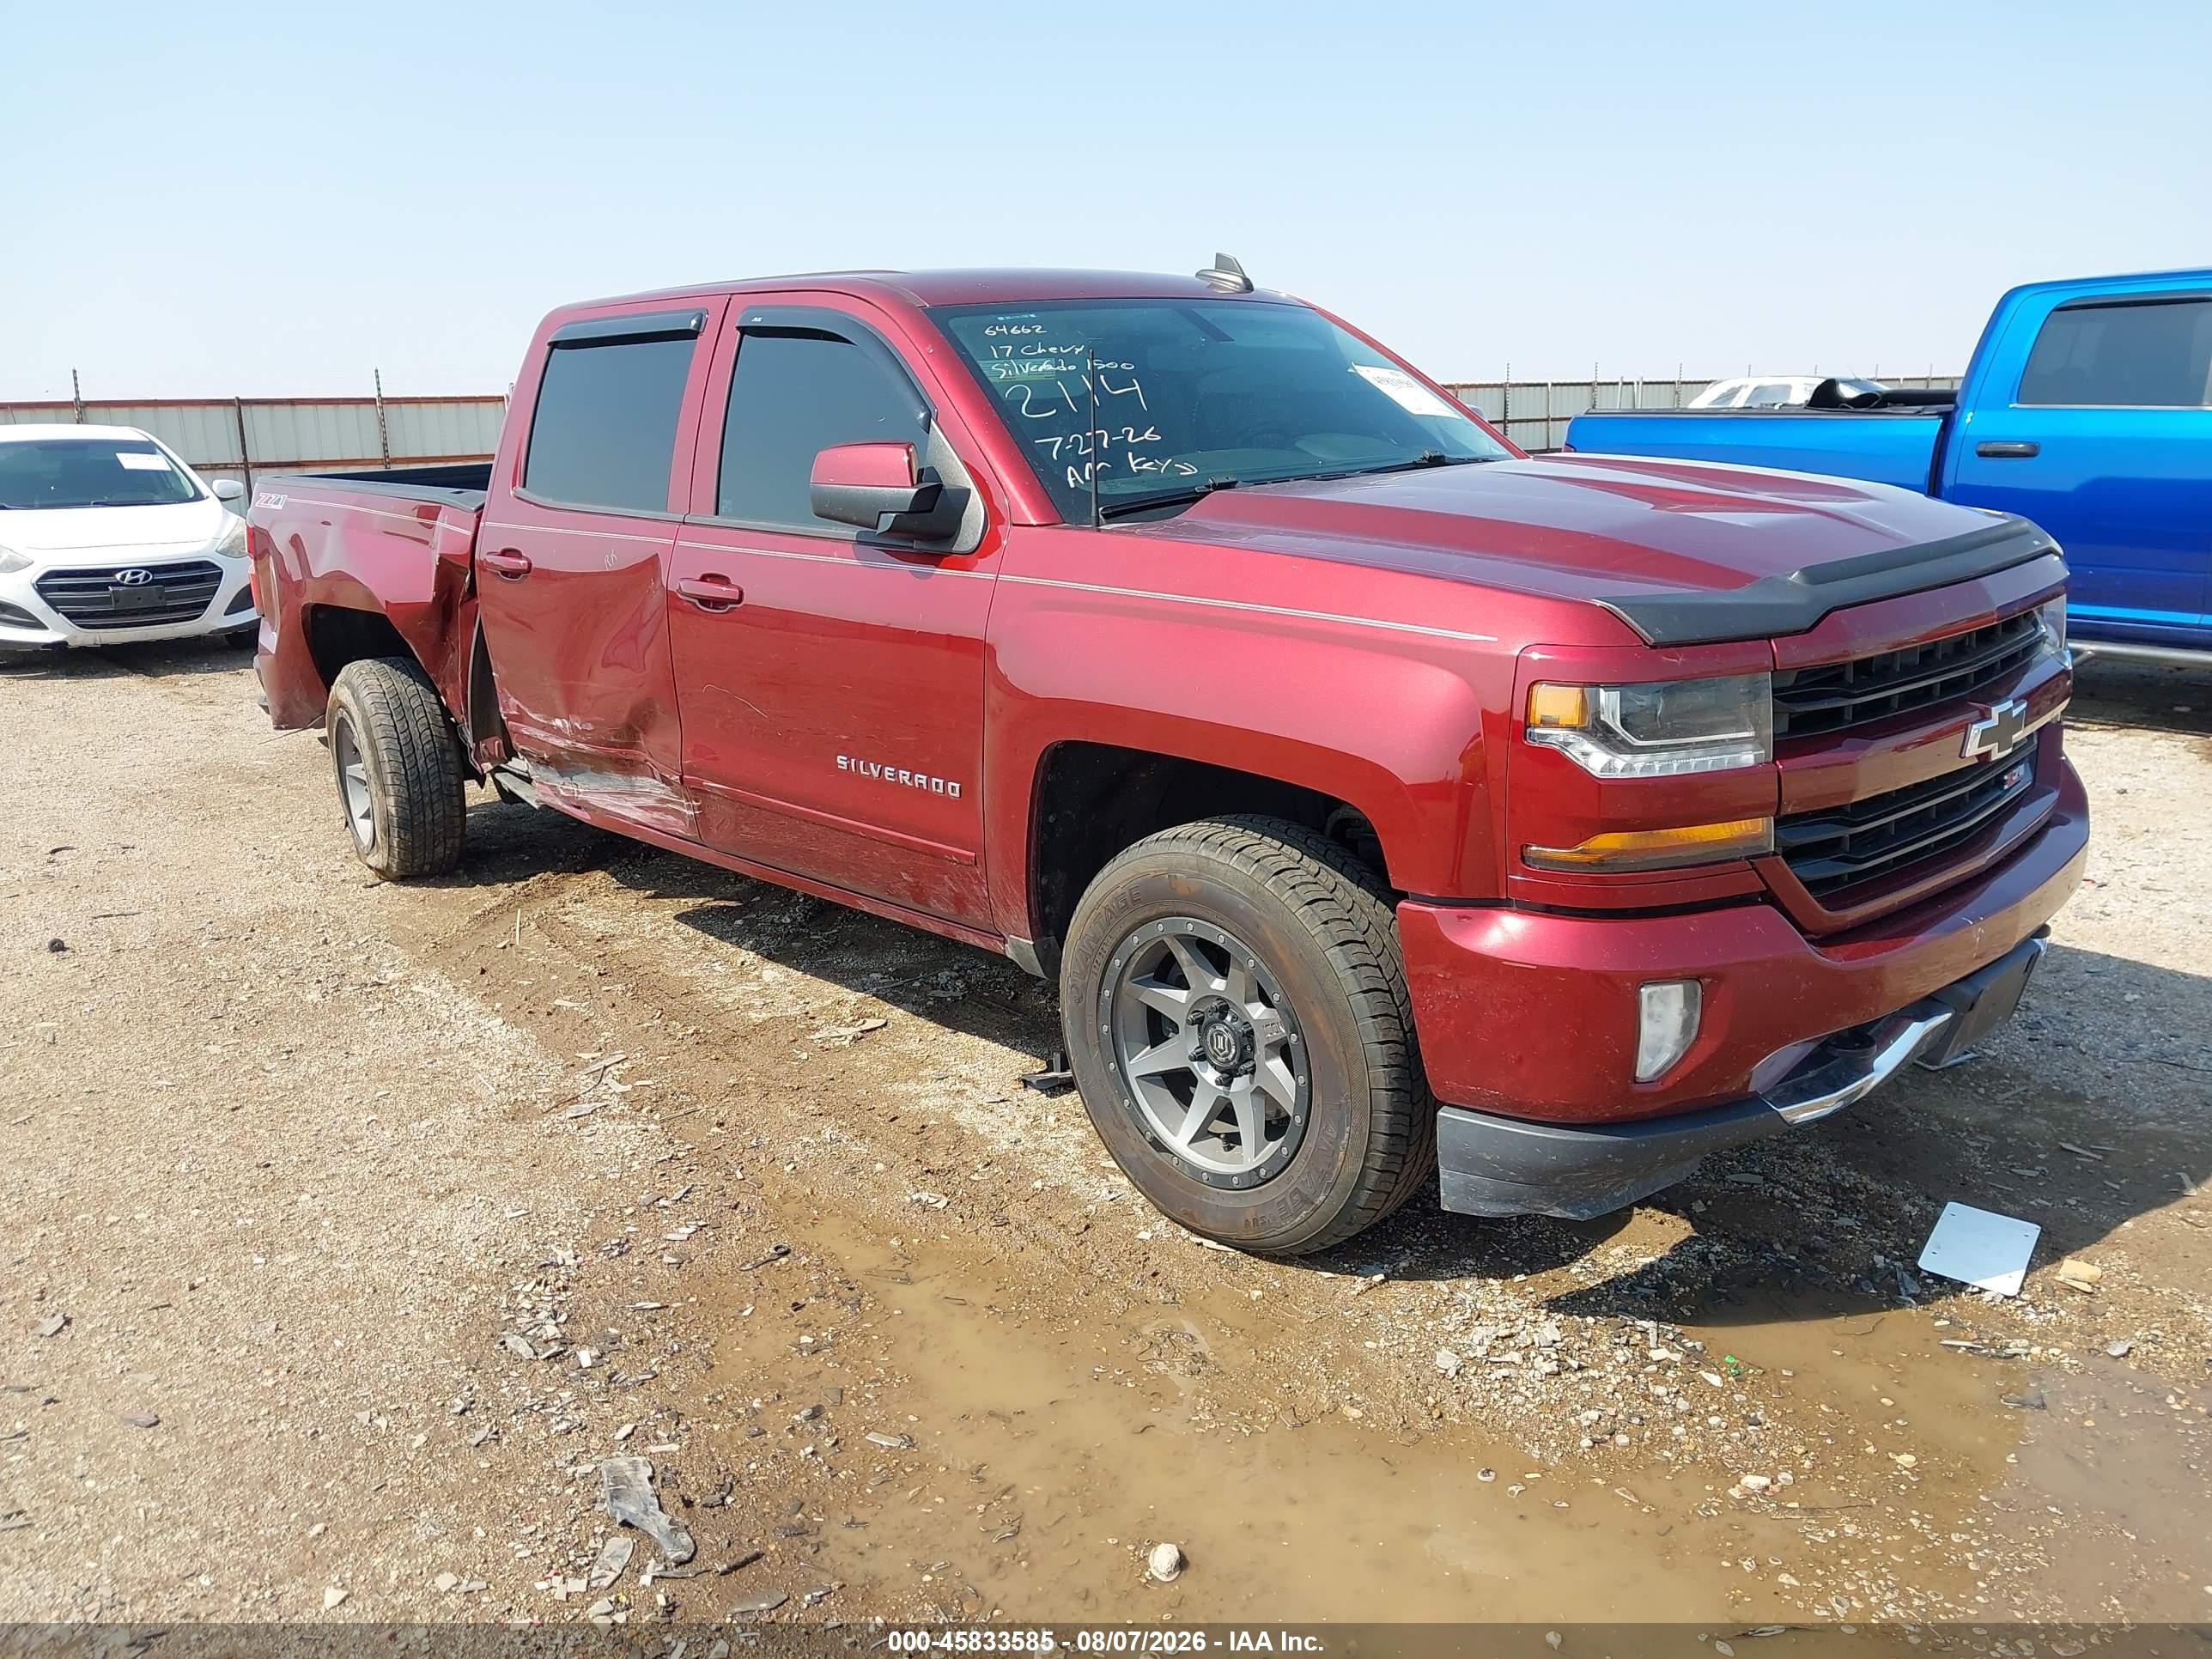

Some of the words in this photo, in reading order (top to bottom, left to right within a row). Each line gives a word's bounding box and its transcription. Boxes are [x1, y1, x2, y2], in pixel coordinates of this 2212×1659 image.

[985, 325, 1048, 337] 64662
[990, 345, 1012, 359] 17
[1086, 358, 1135, 371] 1500
[1006, 374, 1148, 418] 2114
[1035, 426, 1162, 461] 7-27-26
[255, 492, 289, 510] Z71
[836, 755, 962, 799] SILVERADO
